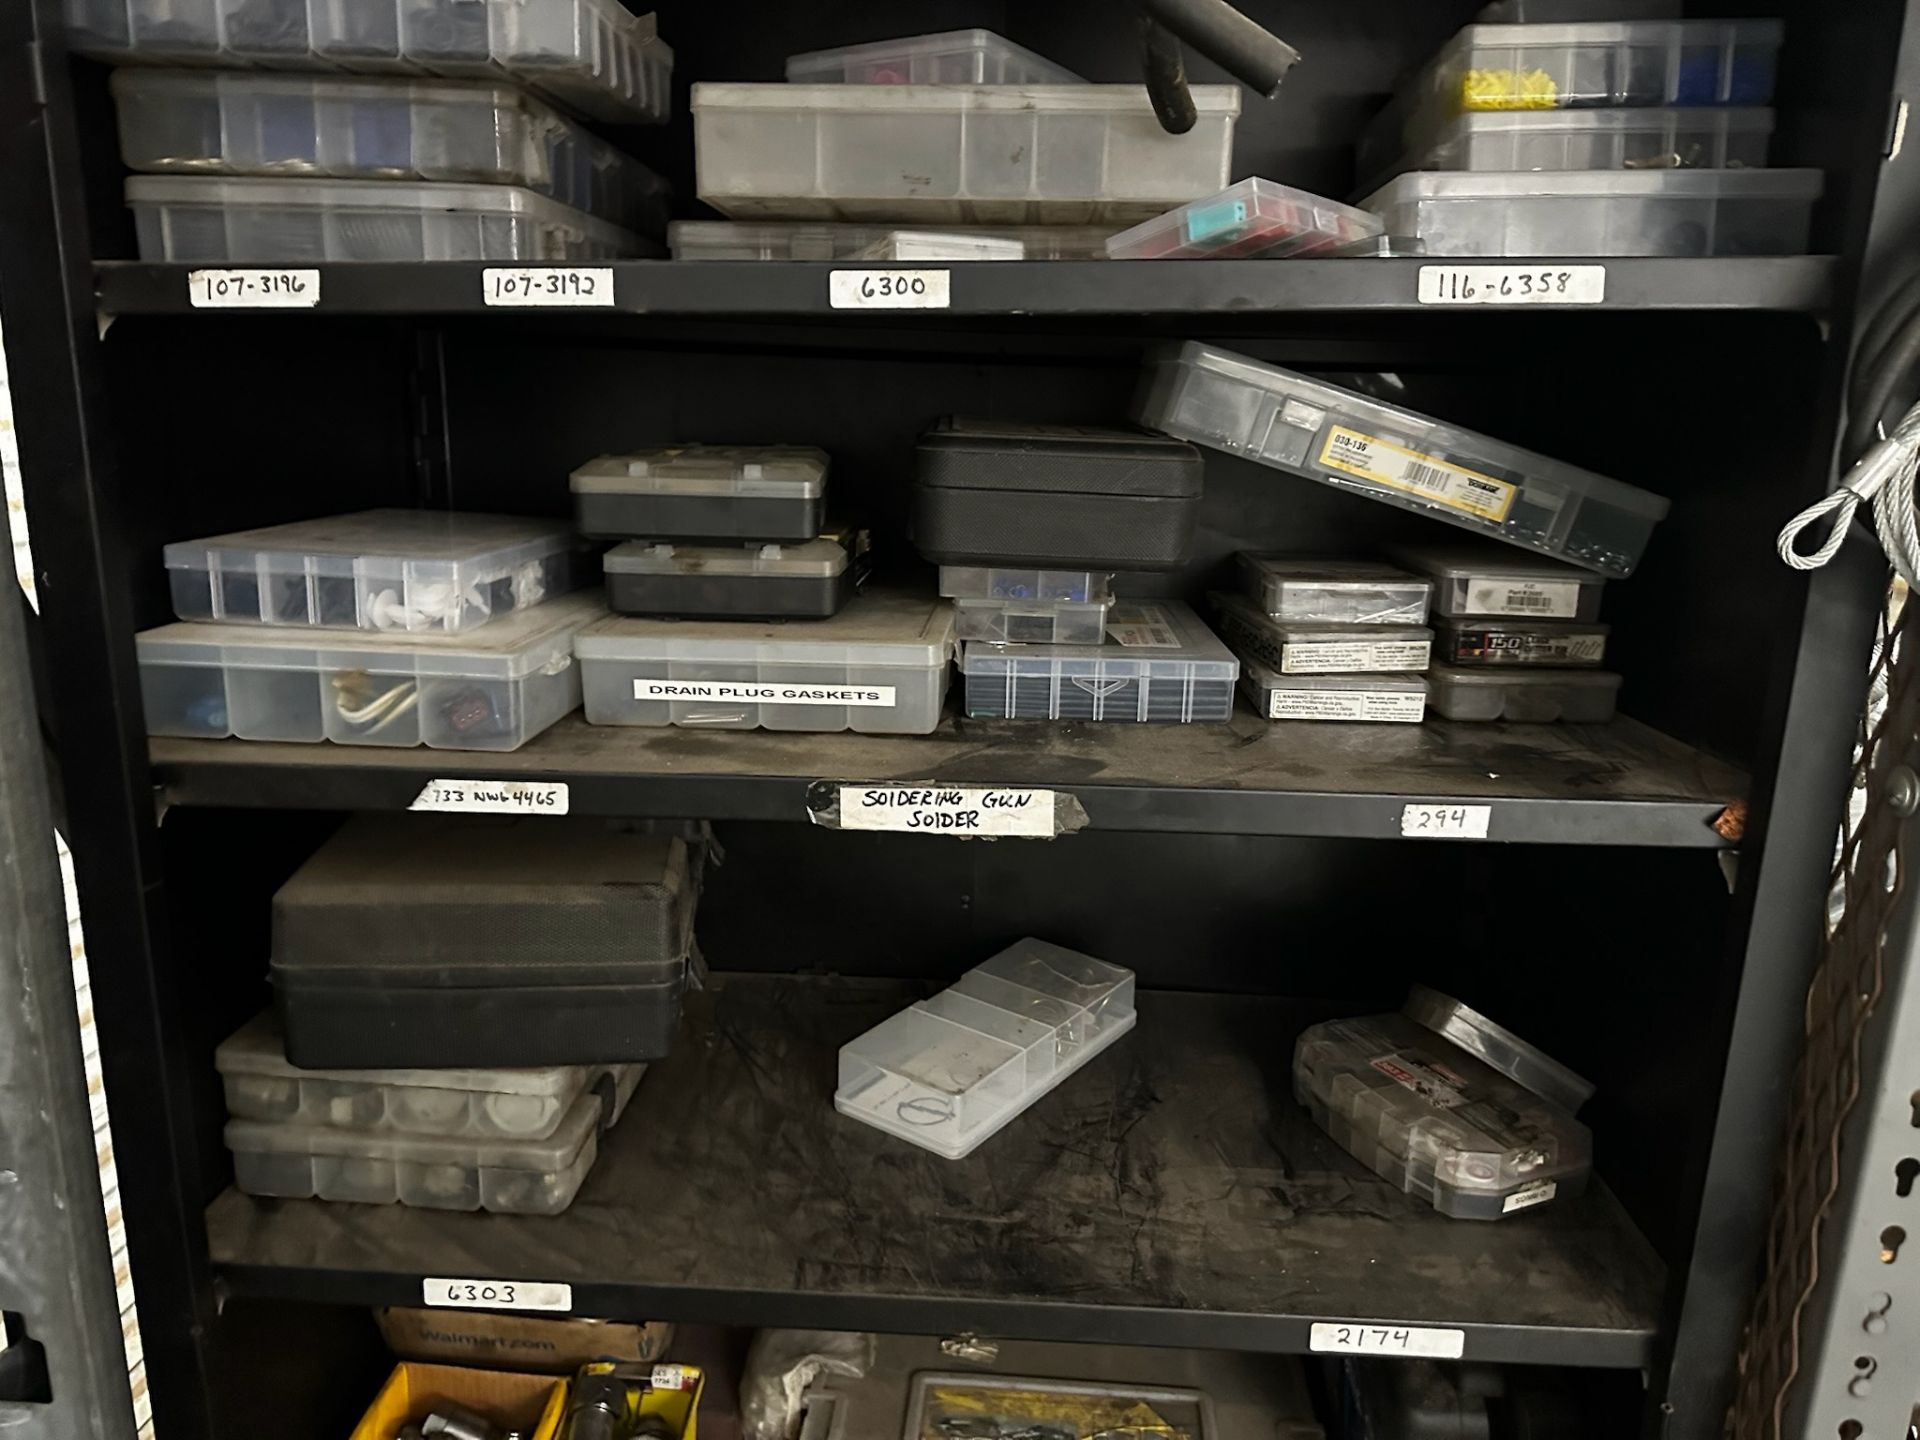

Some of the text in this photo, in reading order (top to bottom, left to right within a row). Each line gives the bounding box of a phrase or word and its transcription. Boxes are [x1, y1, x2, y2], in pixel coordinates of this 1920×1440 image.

[207, 274, 306, 301] 107-3196
[495, 273, 595, 298] 107-3192
[861, 276, 925, 298] 6300
[1438, 272, 1572, 300] 116-6358
[1490, 637, 1521, 649] 150
[649, 685, 880, 700] DRAIN PLUG GASKETS
[982, 791, 1033, 808] GUN
[1416, 808, 1466, 829] 294
[447, 1285, 515, 1303] 6303
[1337, 1327, 1410, 1348] 2174
